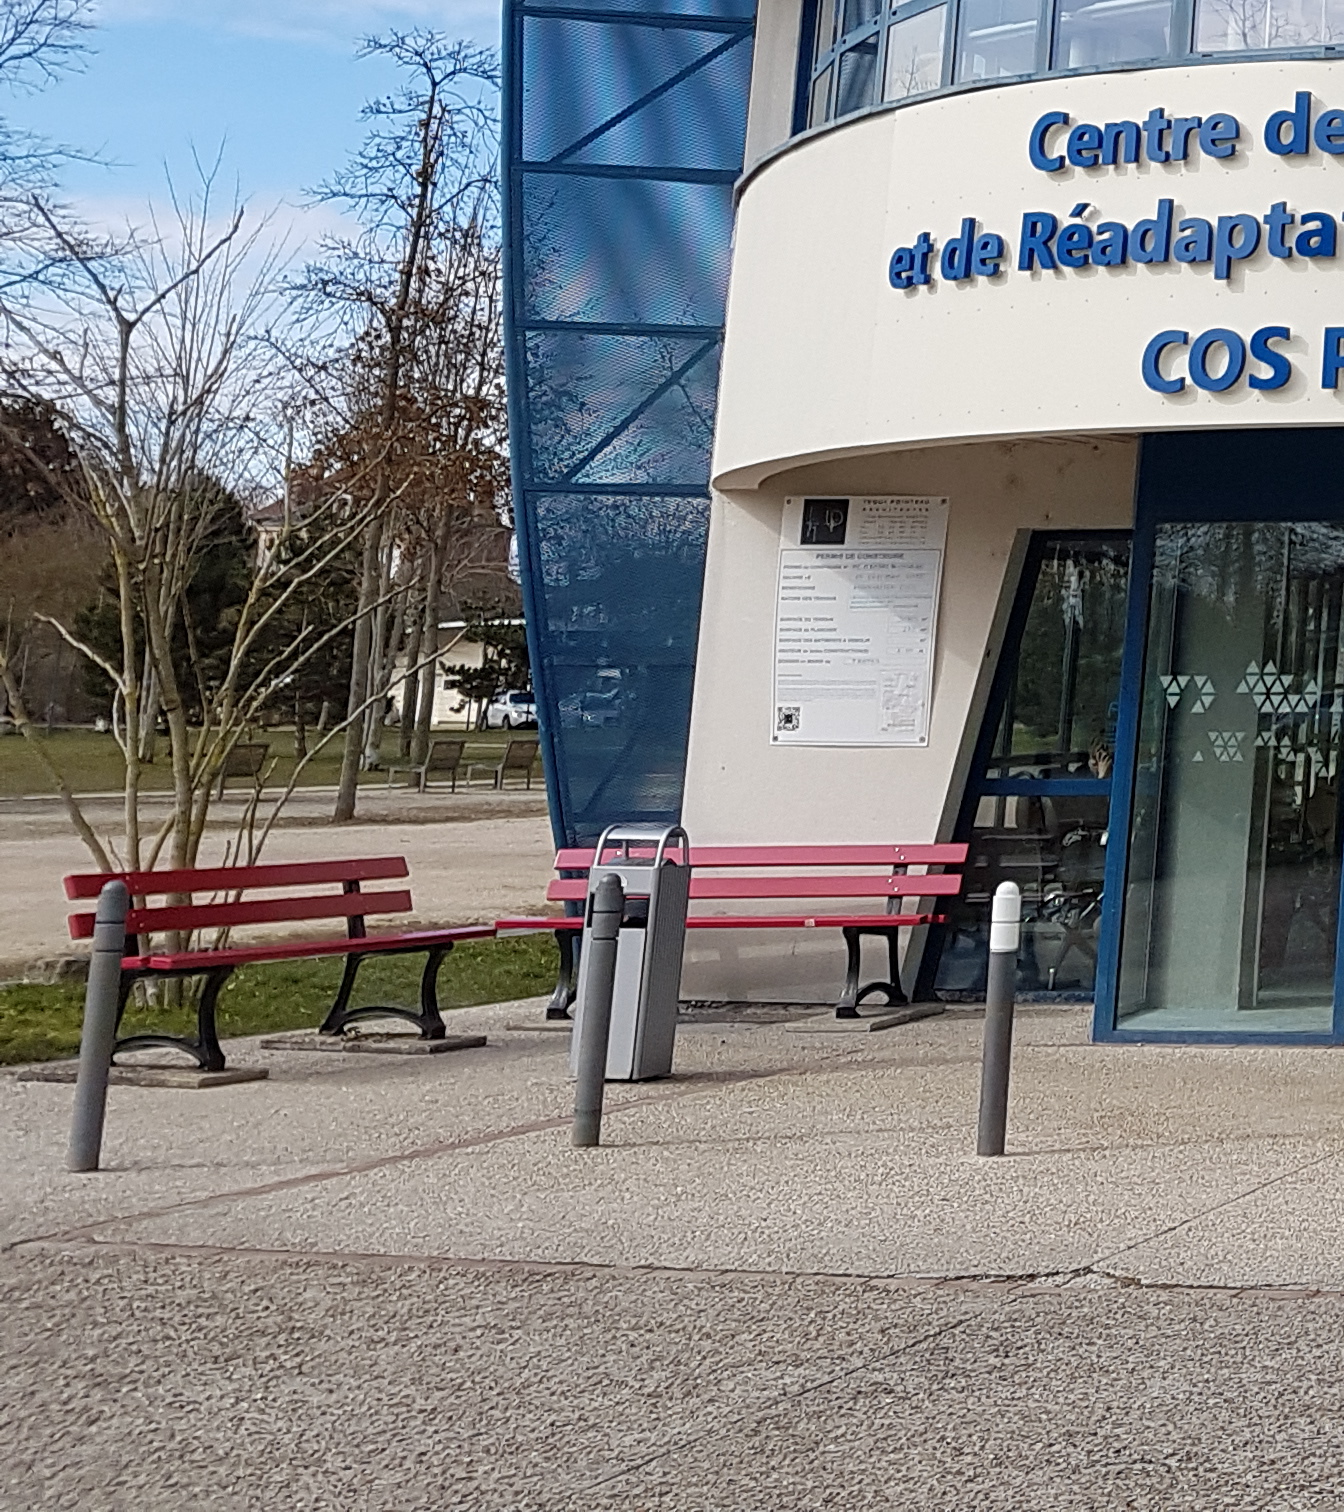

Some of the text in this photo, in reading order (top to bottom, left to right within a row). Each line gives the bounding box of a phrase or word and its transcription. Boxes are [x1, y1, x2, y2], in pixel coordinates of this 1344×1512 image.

[1030, 109, 1240, 172] Centre
[889, 232, 934, 289] et
[941, 218, 1004, 281] de
[1142, 326, 1291, 393] COS
